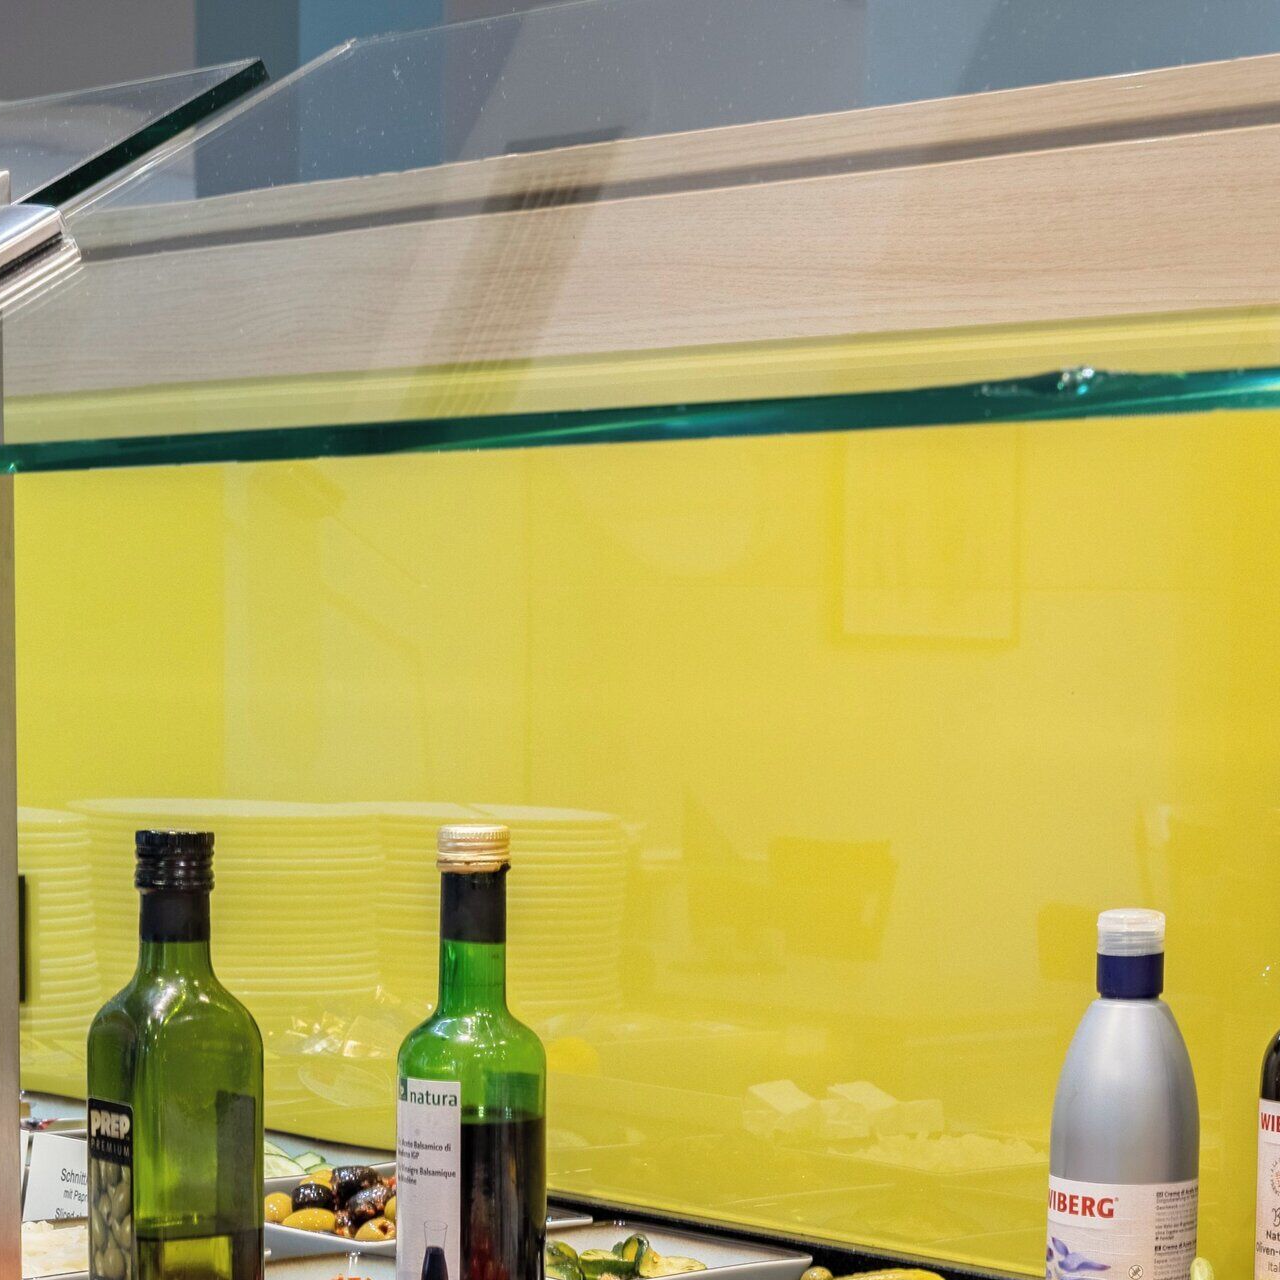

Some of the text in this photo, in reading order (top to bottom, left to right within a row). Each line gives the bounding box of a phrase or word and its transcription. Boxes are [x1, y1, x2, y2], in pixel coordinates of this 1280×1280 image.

[410, 1090, 458, 1107] natura
[90, 1110, 130, 1139] PREP
[90, 1138, 129, 1157] PREMIUM
[413, 1140, 443, 1151] Balsamico
[444, 1143, 451, 1152] di
[61, 1168, 87, 1185] Schnitt
[419, 1167, 456, 1179] Balsamique
[73, 1190, 87, 1204] Papr
